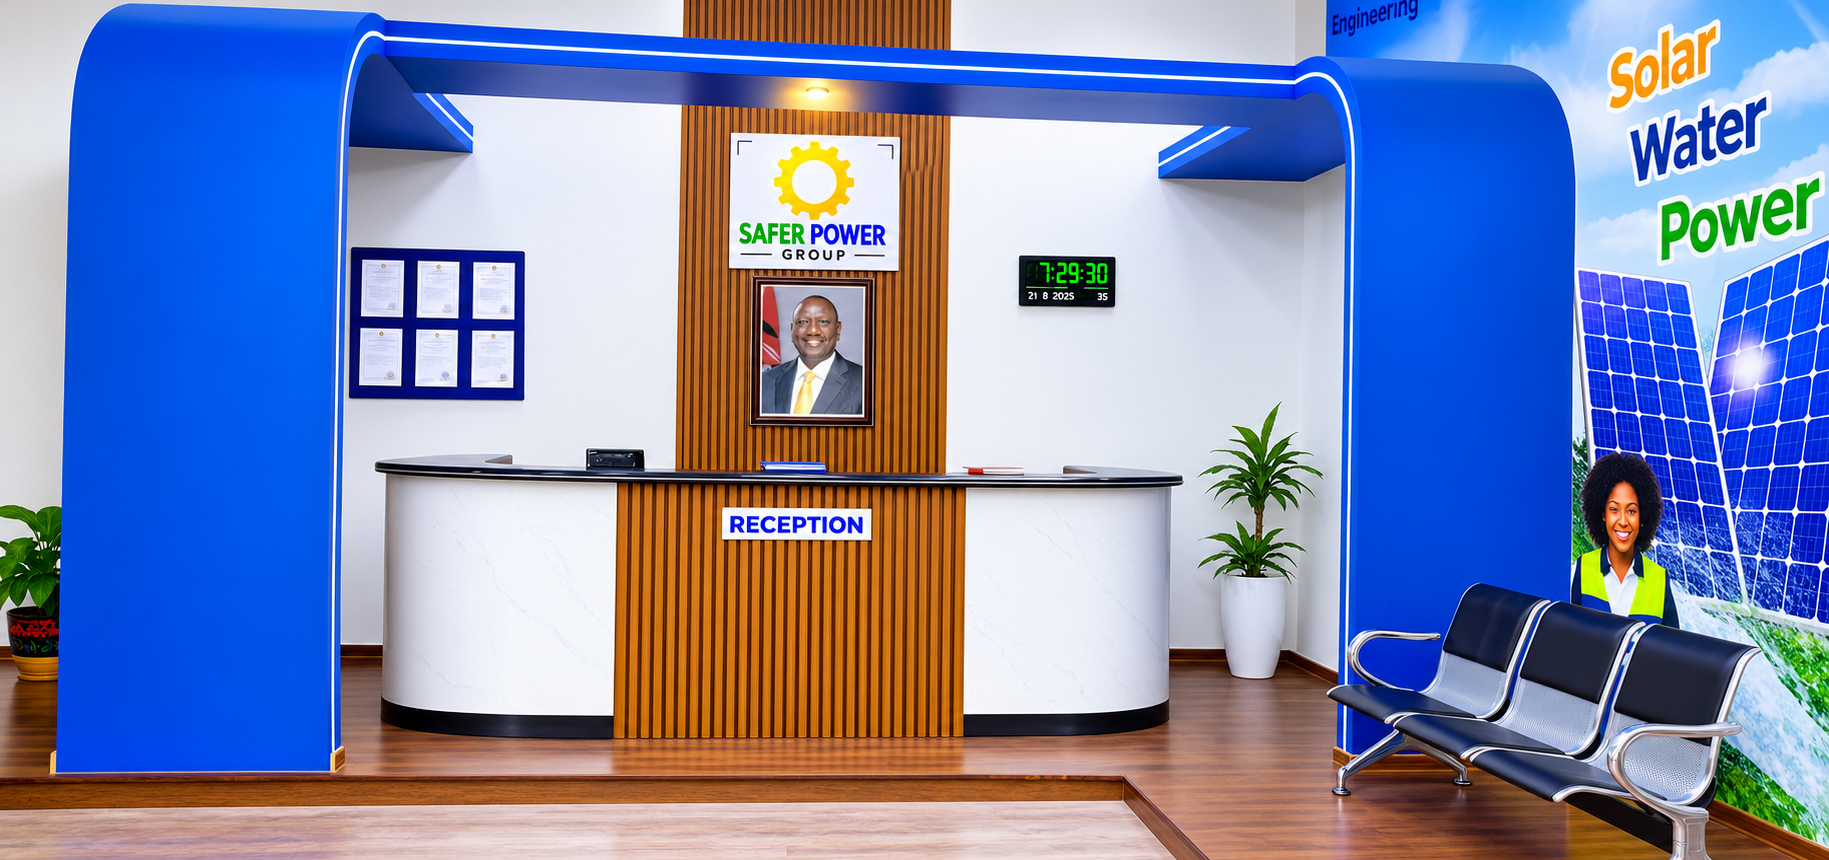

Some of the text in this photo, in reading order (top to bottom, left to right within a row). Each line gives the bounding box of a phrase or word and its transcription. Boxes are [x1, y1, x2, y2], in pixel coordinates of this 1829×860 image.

[1332, 0, 1418, 37] Engineering
[1609, 25, 1717, 109] Solar
[1630, 96, 1767, 182] Water
[739, 222, 886, 246] SAFER POWER
[1661, 177, 1820, 261] Power
[782, 249, 846, 261] GROUP
[1028, 291, 1038, 300] 21
[1042, 291, 1049, 300] 8
[729, 515, 863, 535] RECEPTION
